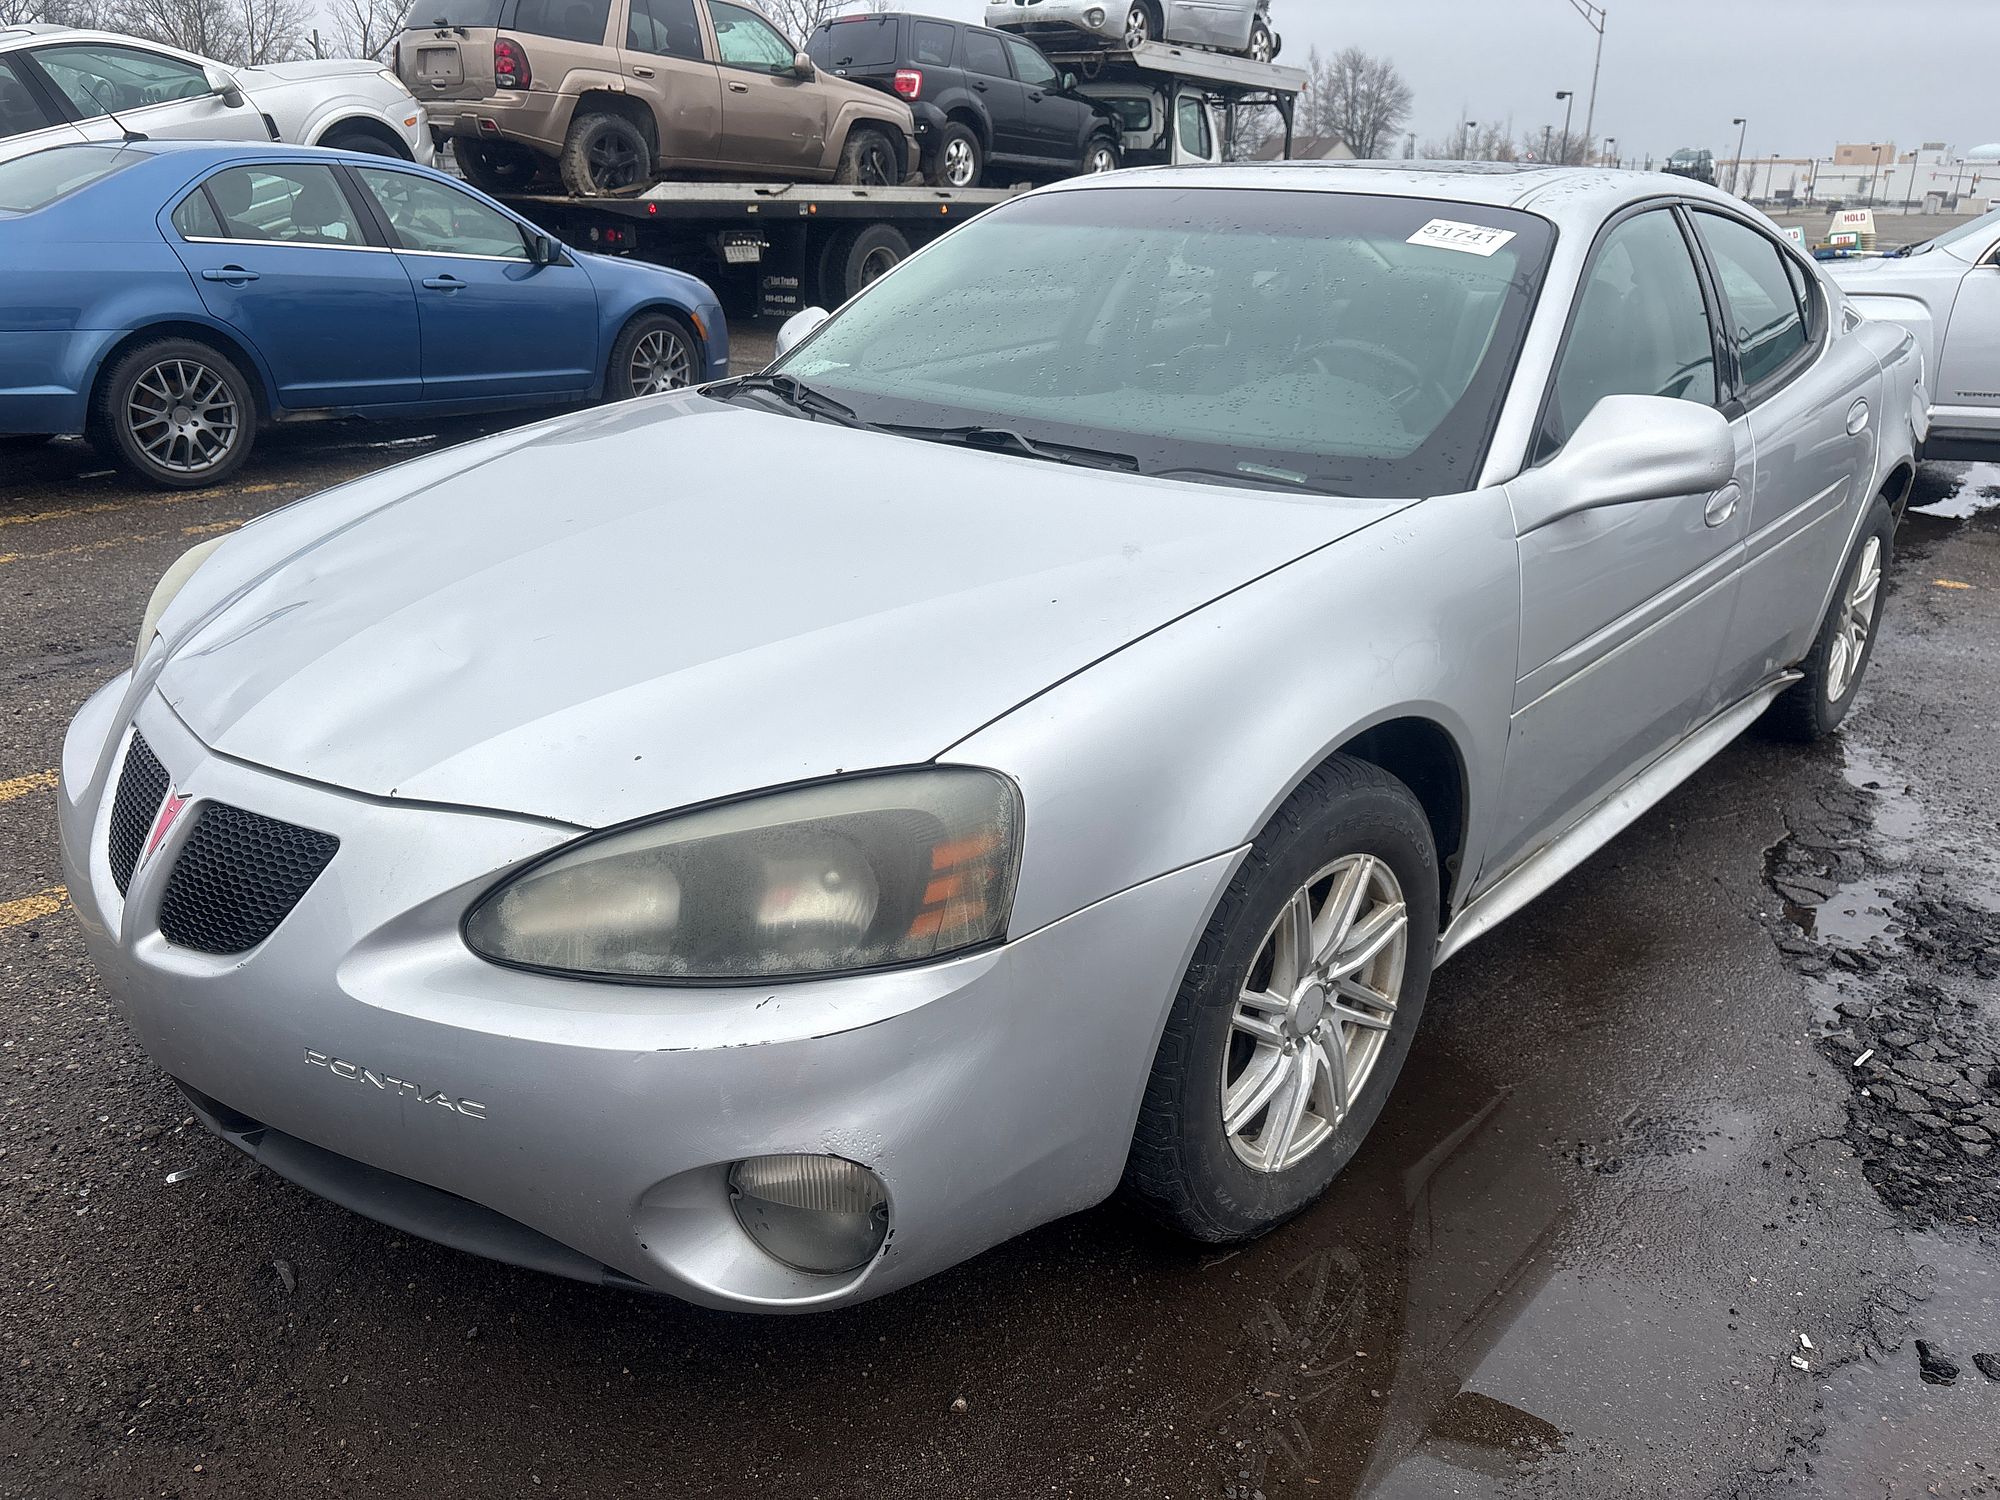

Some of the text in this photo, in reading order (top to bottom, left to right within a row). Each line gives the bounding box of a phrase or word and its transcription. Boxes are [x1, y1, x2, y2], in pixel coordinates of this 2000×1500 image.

[1843, 212, 1866, 223] HOLD
[1423, 225, 1497, 243] 51741
[304, 1047, 486, 1120] PONTIAC
